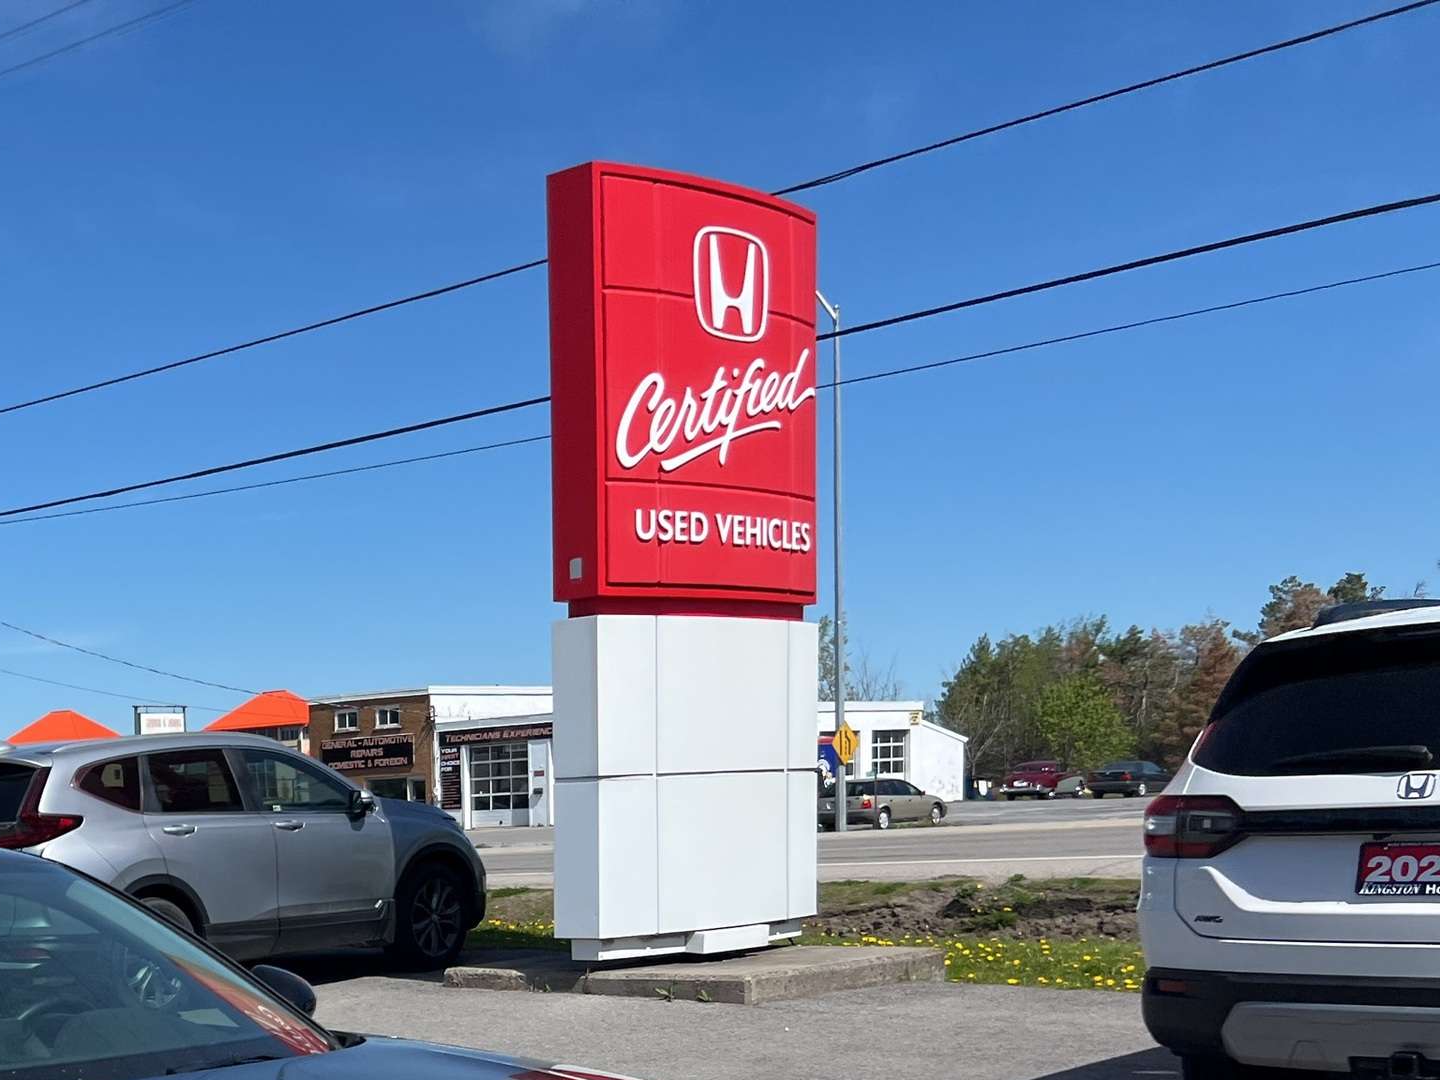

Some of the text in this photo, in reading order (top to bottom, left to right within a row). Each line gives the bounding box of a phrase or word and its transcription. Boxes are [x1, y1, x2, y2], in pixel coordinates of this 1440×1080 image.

[616, 348, 815, 471] Certified
[635, 509, 811, 552] USED VEHICLES
[321, 740, 357, 749] GENERAL
[363, 735, 413, 746] AUTOMOTIVE
[351, 748, 384, 758] REPAIRS
[374, 757, 408, 767] FOREIGN
